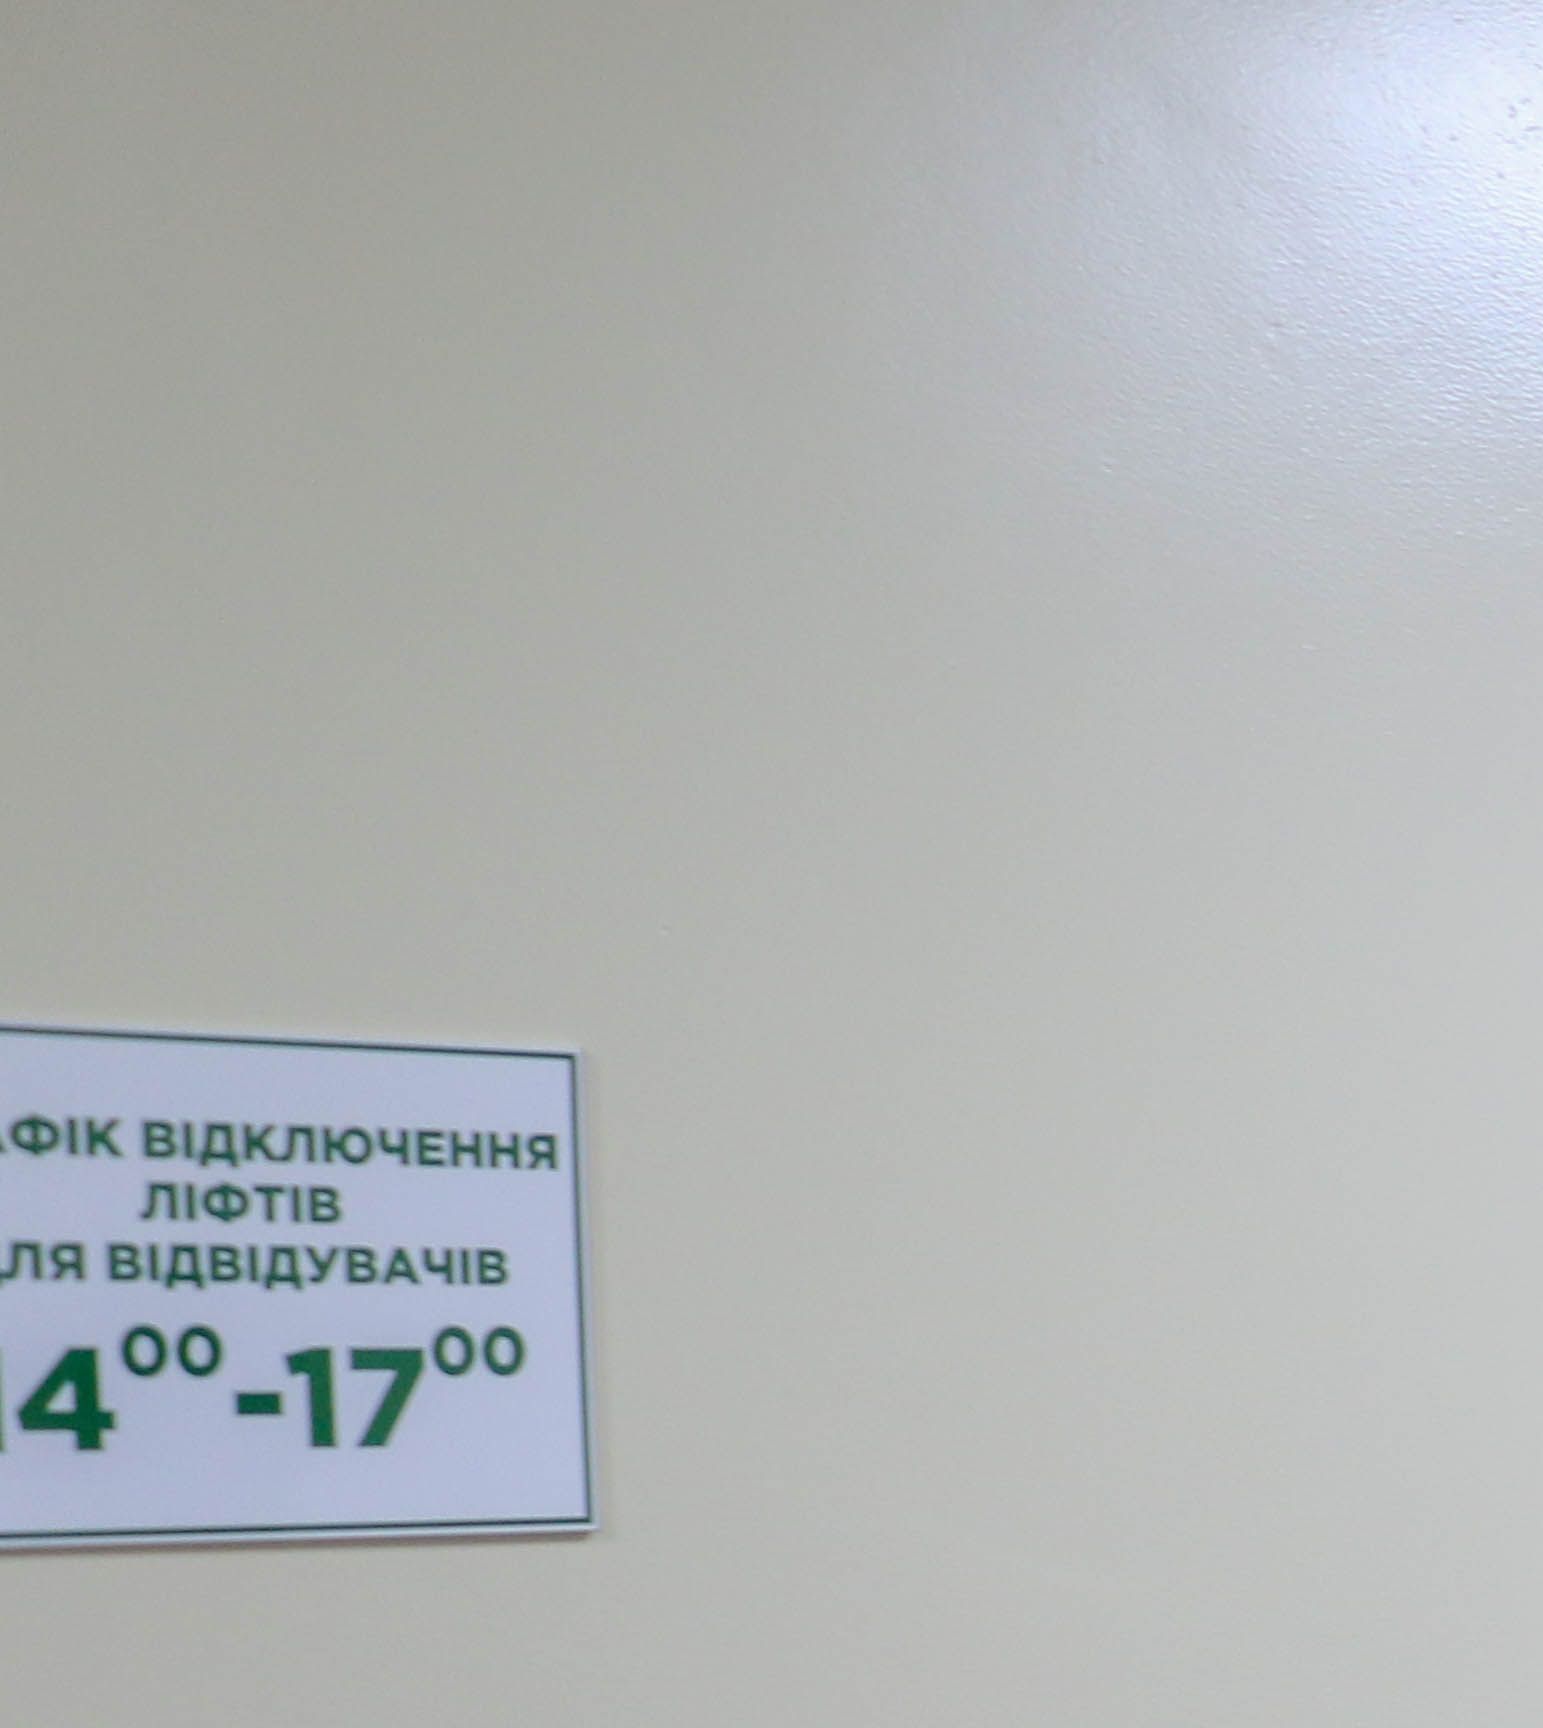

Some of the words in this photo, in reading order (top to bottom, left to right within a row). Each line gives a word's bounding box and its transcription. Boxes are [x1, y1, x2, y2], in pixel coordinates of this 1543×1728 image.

[0, 1115, 124, 1159] ФІК
[142, 1119, 560, 1170] ВІДКЛЮЧЕННЯ
[139, 1181, 344, 1224] ЛІФТІВ
[0, 1241, 87, 1287] ЛЯ
[106, 1243, 511, 1290] ВІДВІДУВАЧІВ
